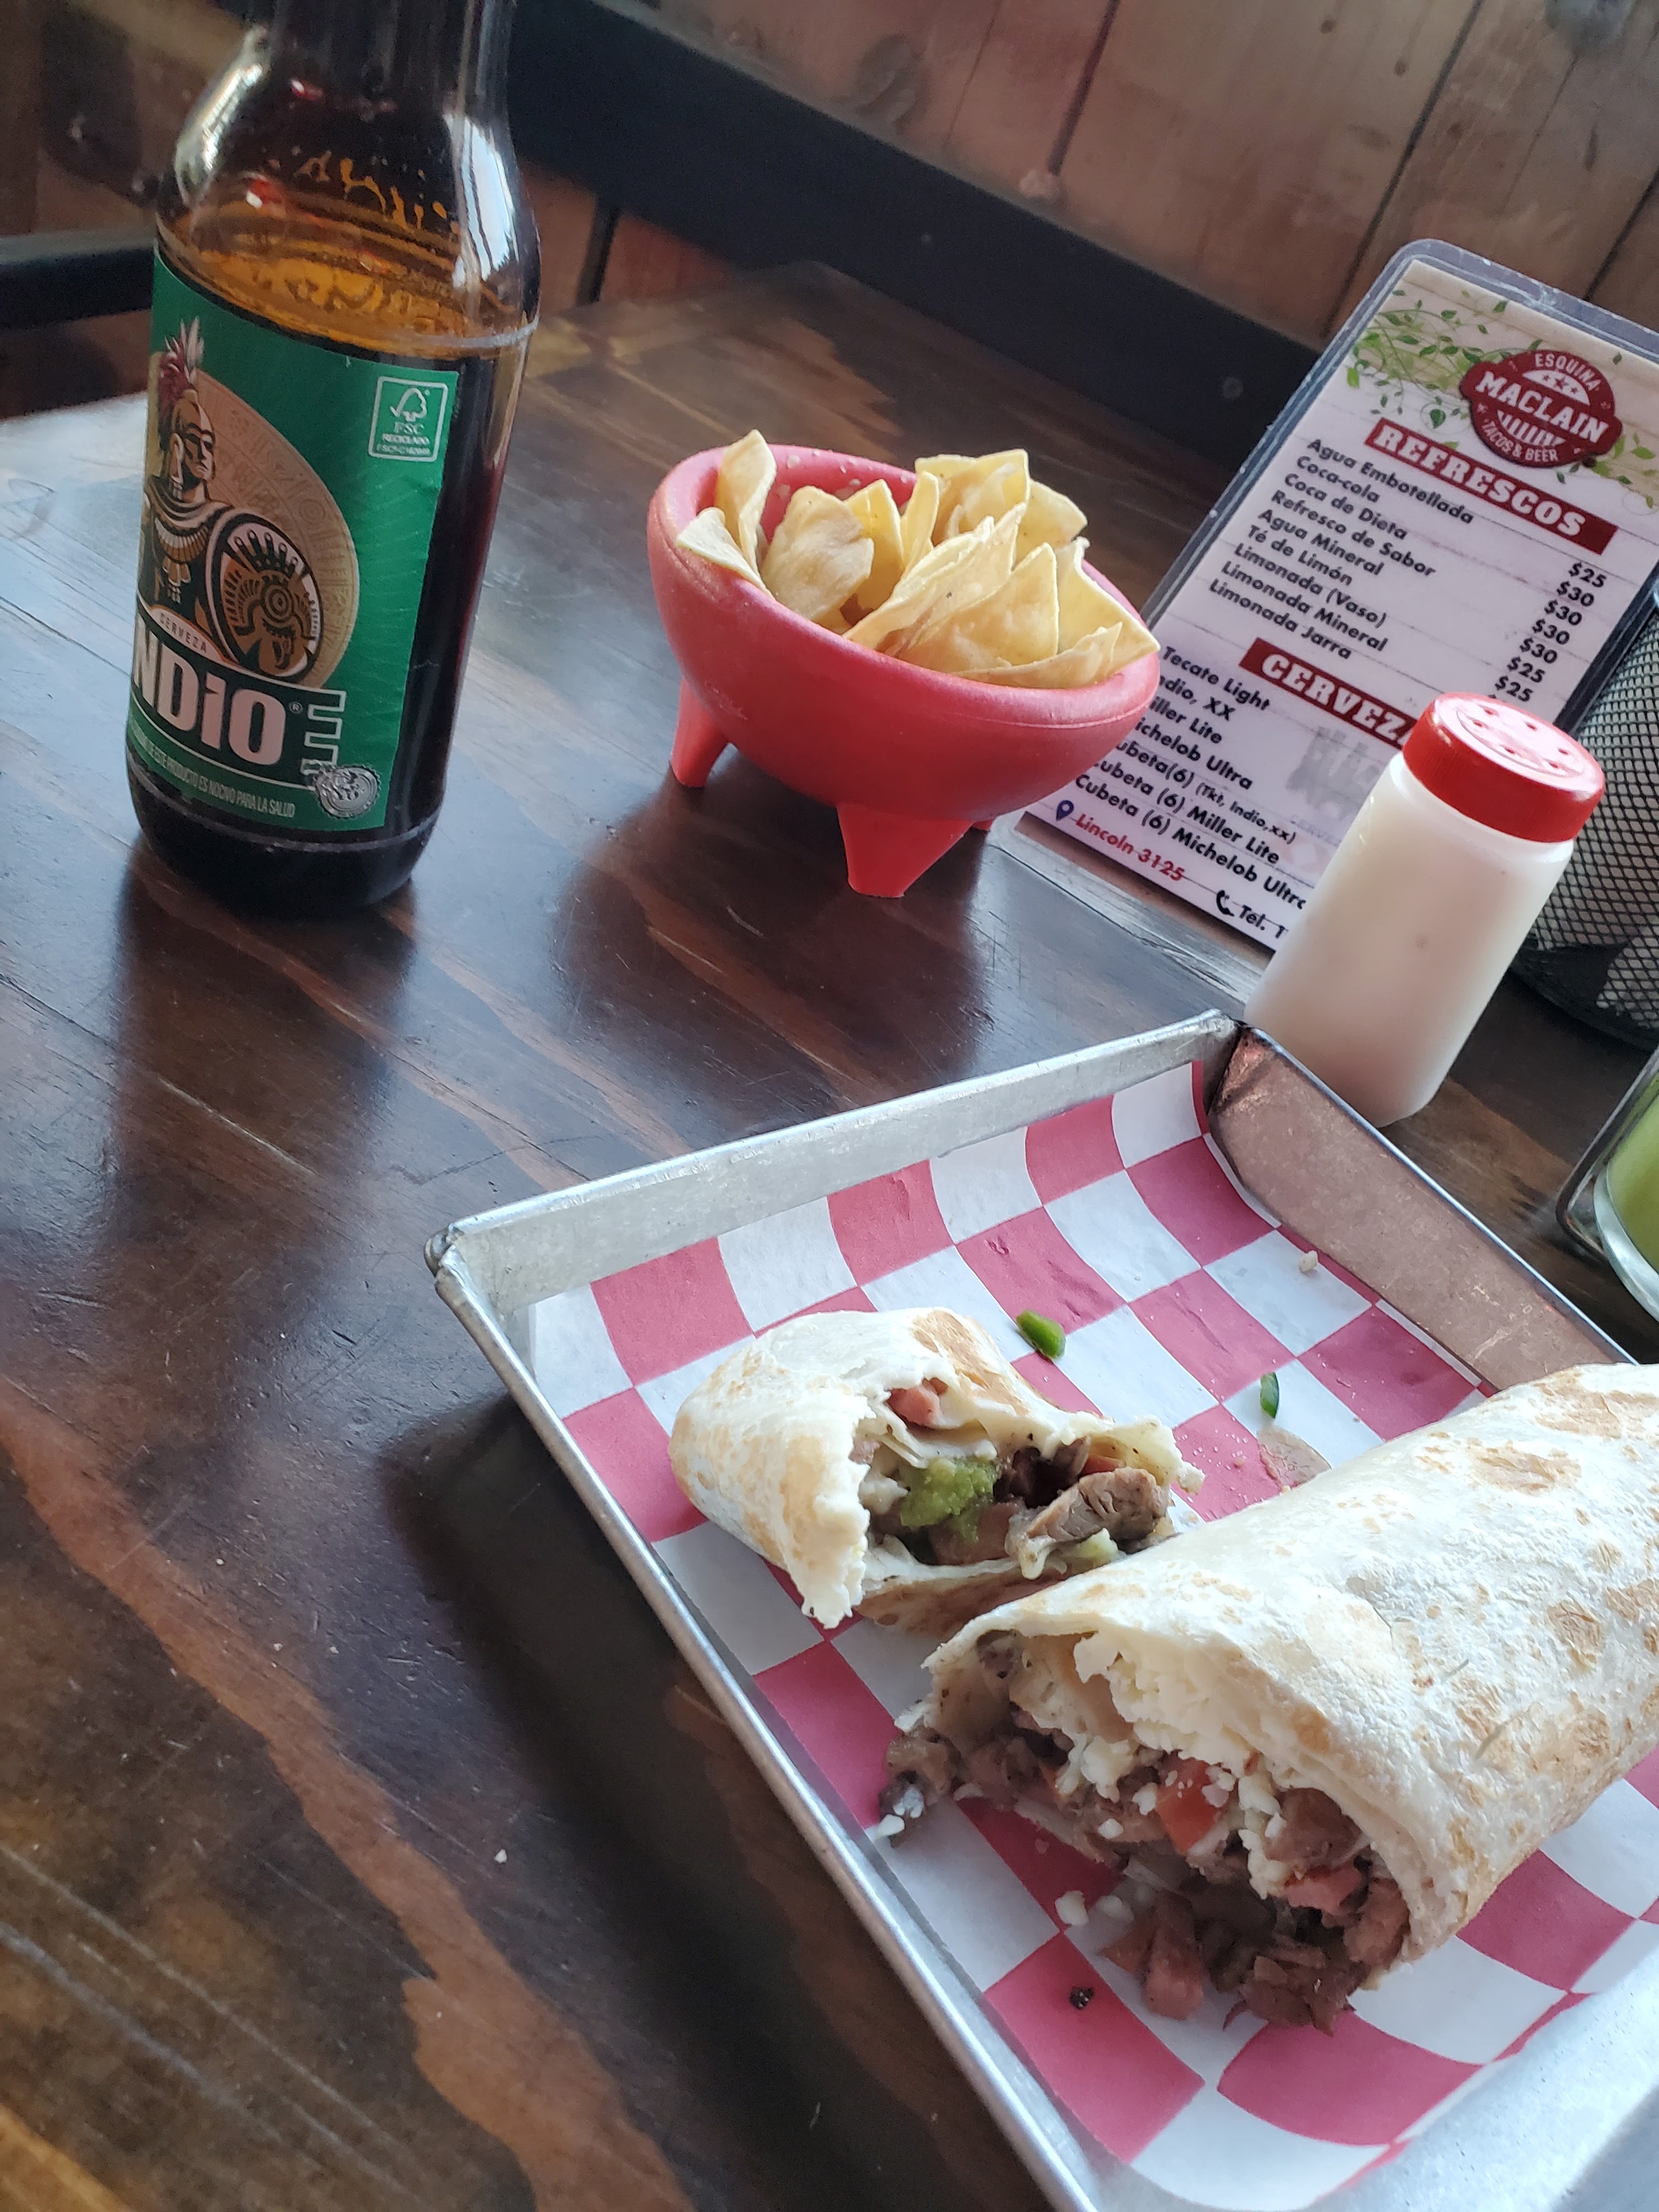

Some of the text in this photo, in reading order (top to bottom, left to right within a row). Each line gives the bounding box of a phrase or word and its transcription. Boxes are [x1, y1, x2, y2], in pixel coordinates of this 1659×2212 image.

[1475, 370, 1610, 443] MACLAIN
[1535, 353, 1601, 391] ESQUINA
[1373, 427, 1586, 537] REFRESCOS
[1482, 420, 1514, 453] TACOS
[1525, 449, 1559, 462] BEER
[1285, 473, 1582, 626] Coca de Dieta $30
[1296, 455, 1594, 607] Coca-cola $30
[1307, 439, 1607, 588] Agua Embotellada $25
[1221, 561, 1389, 652] Limonada Mineral
[1247, 525, 1546, 683] Té de Limón $25
[1258, 509, 1558, 664] Agua Mineral $30
[1271, 489, 1570, 645] Refresco de Sabor $30
[159, 612, 207, 653] CERVEZA
[1209, 578, 1352, 660] Limonada Jarra
[1234, 543, 1534, 702] Limonada (Vaso) $25
[133, 611, 286, 765] NDiO
[1159, 675, 1236, 721] ndio, XX
[1163, 646, 1271, 711] Tecate Light
[1135, 716, 1254, 790] ichelob Ultra
[1149, 696, 1222, 744] iller Lite
[1115, 741, 1195, 789] ubeta(6)
[257, 796, 268, 812] LA
[269, 798, 296, 818] SALUD
[1075, 774, 1139, 817] Cubeta
[1141, 809, 1171, 836] (6)
[1171, 827, 1258, 883] Michelob
[1075, 812, 1187, 882] Lincoln 3125
[1094, 760, 1280, 865] ubeta (6) Miller Lite
[1239, 904, 1266, 932] Tel.
